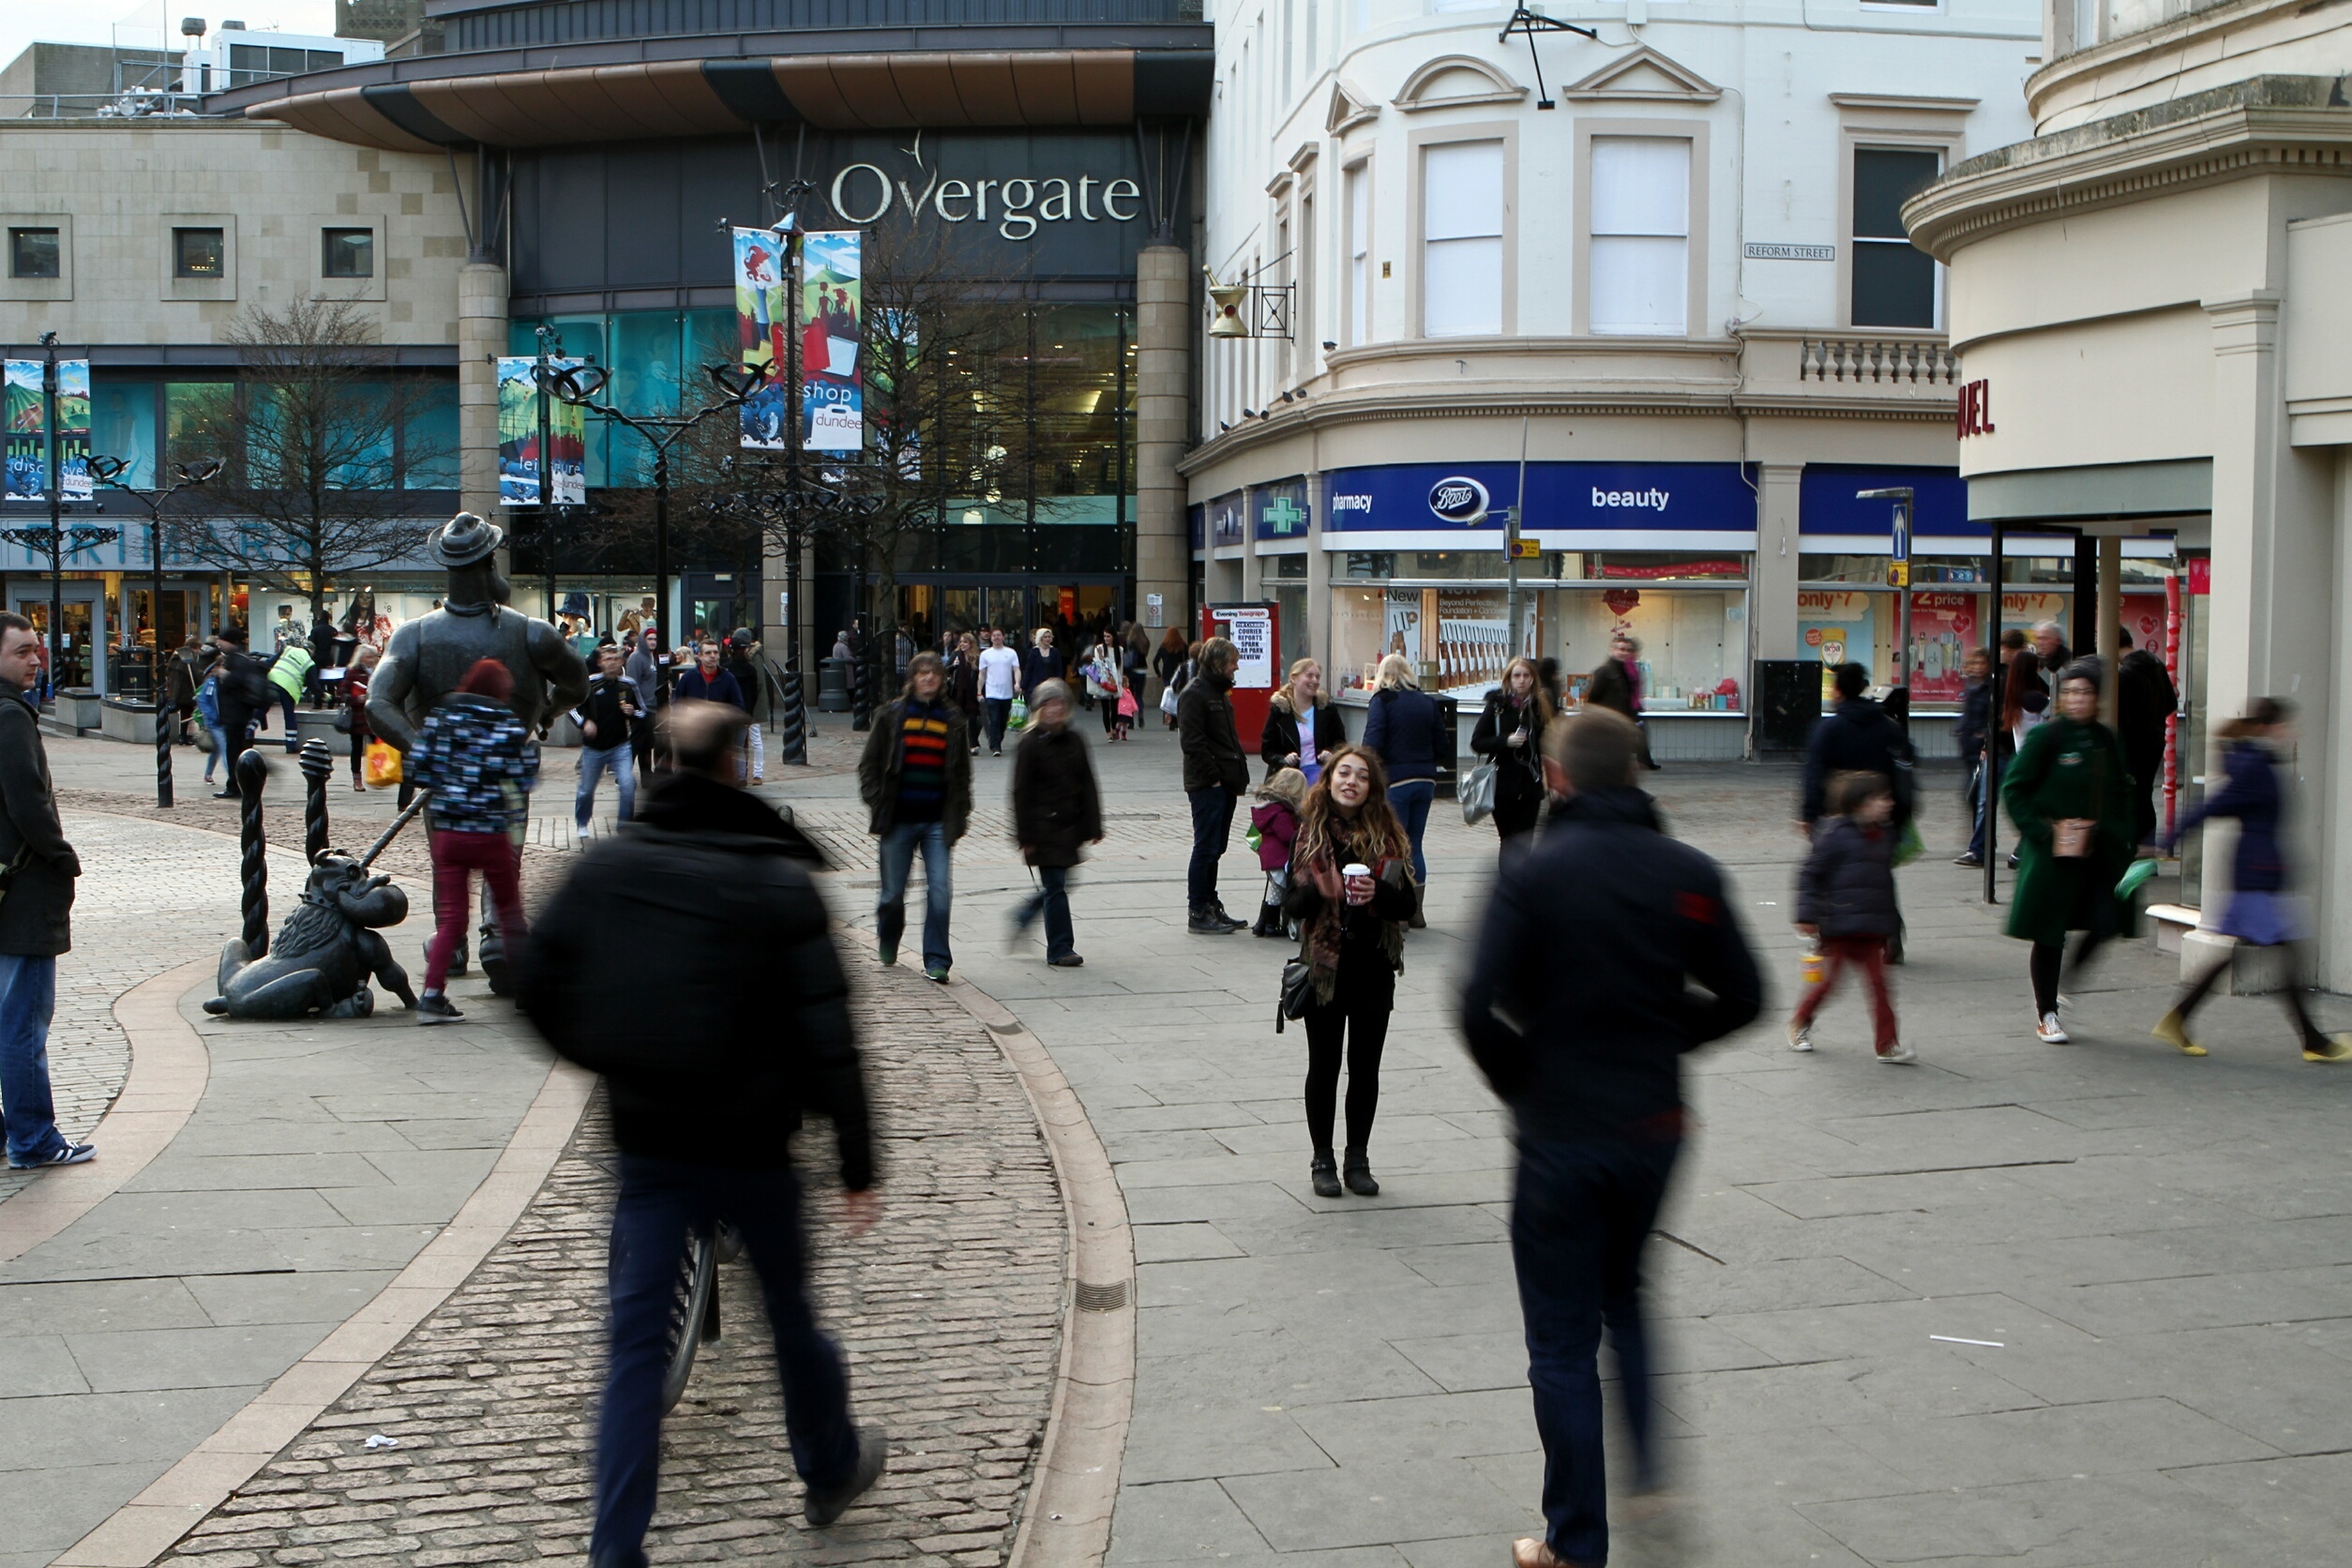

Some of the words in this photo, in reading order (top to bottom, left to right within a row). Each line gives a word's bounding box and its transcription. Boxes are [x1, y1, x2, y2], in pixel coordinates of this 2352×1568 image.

[831, 161, 1140, 240] Overgate
[1748, 246, 1790, 257] REFORM
[1794, 248, 1830, 258] STREET
[803, 382, 852, 405] shop
[816, 414, 862, 430] dundee
[520, 456, 537, 471] lei
[66, 476, 93, 488] dundee
[1333, 491, 1372, 514] pharmacy
[1434, 486, 1472, 510] Boots
[1591, 487, 1669, 511] beauty
[1387, 590, 1419, 602] New
[1439, 599, 1464, 608] Beyond
[1465, 599, 1499, 608] Perfecting
[1798, 592, 1833, 611] only
[1935, 595, 1965, 608] price
[2001, 594, 2028, 611] nly
